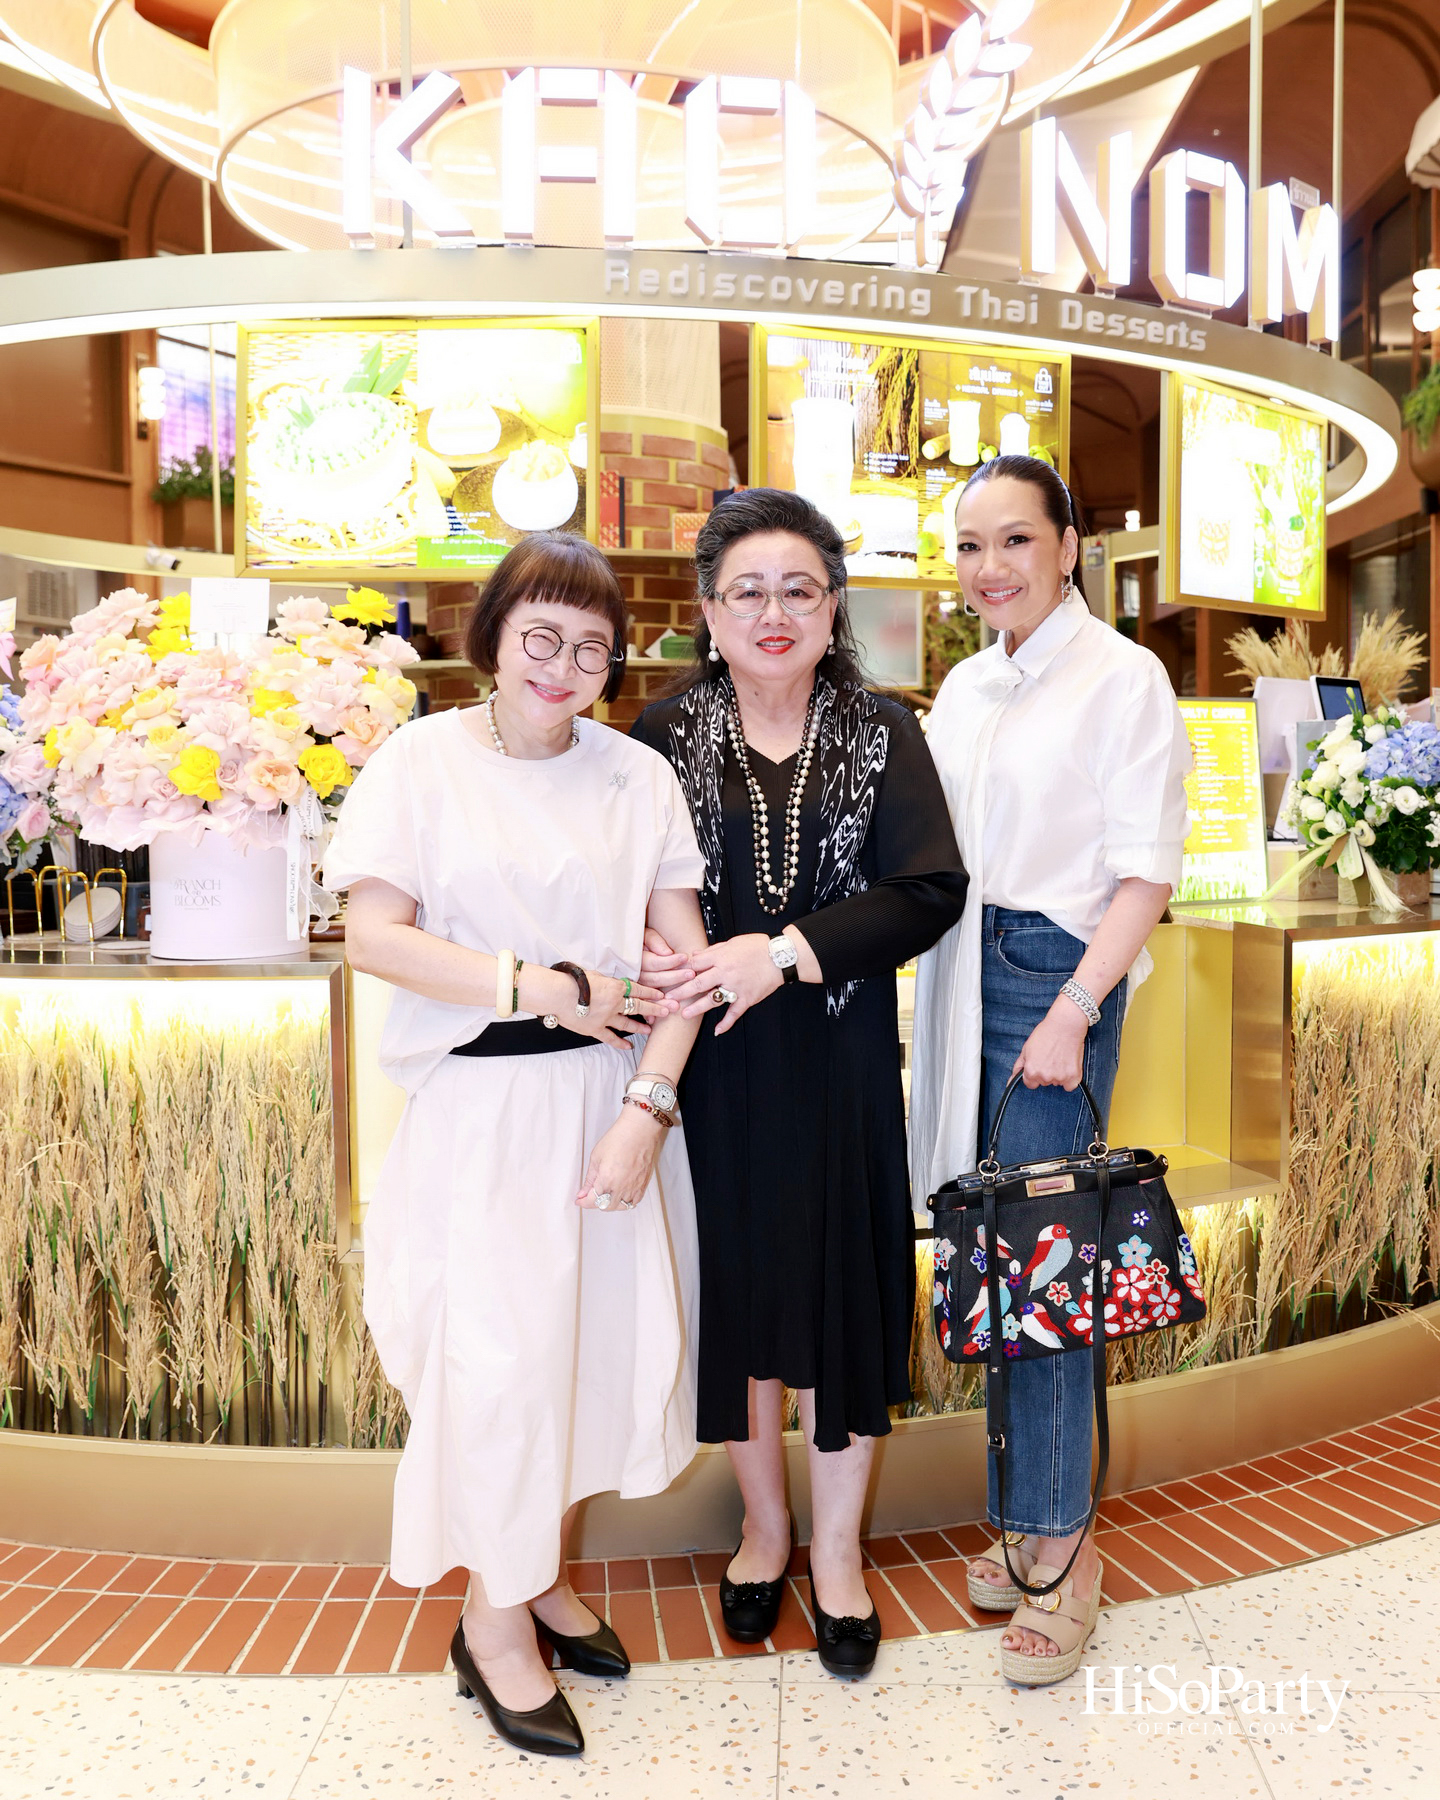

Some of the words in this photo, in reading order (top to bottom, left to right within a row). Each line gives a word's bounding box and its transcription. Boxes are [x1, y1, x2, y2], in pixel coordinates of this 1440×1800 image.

[1020, 116, 1339, 342] NOM
[604, 259, 931, 316] Rediscovering
[955, 285, 1038, 324] Thai
[1060, 298, 1207, 351] Desserts
[174, 895, 221, 907] BLOOMS
